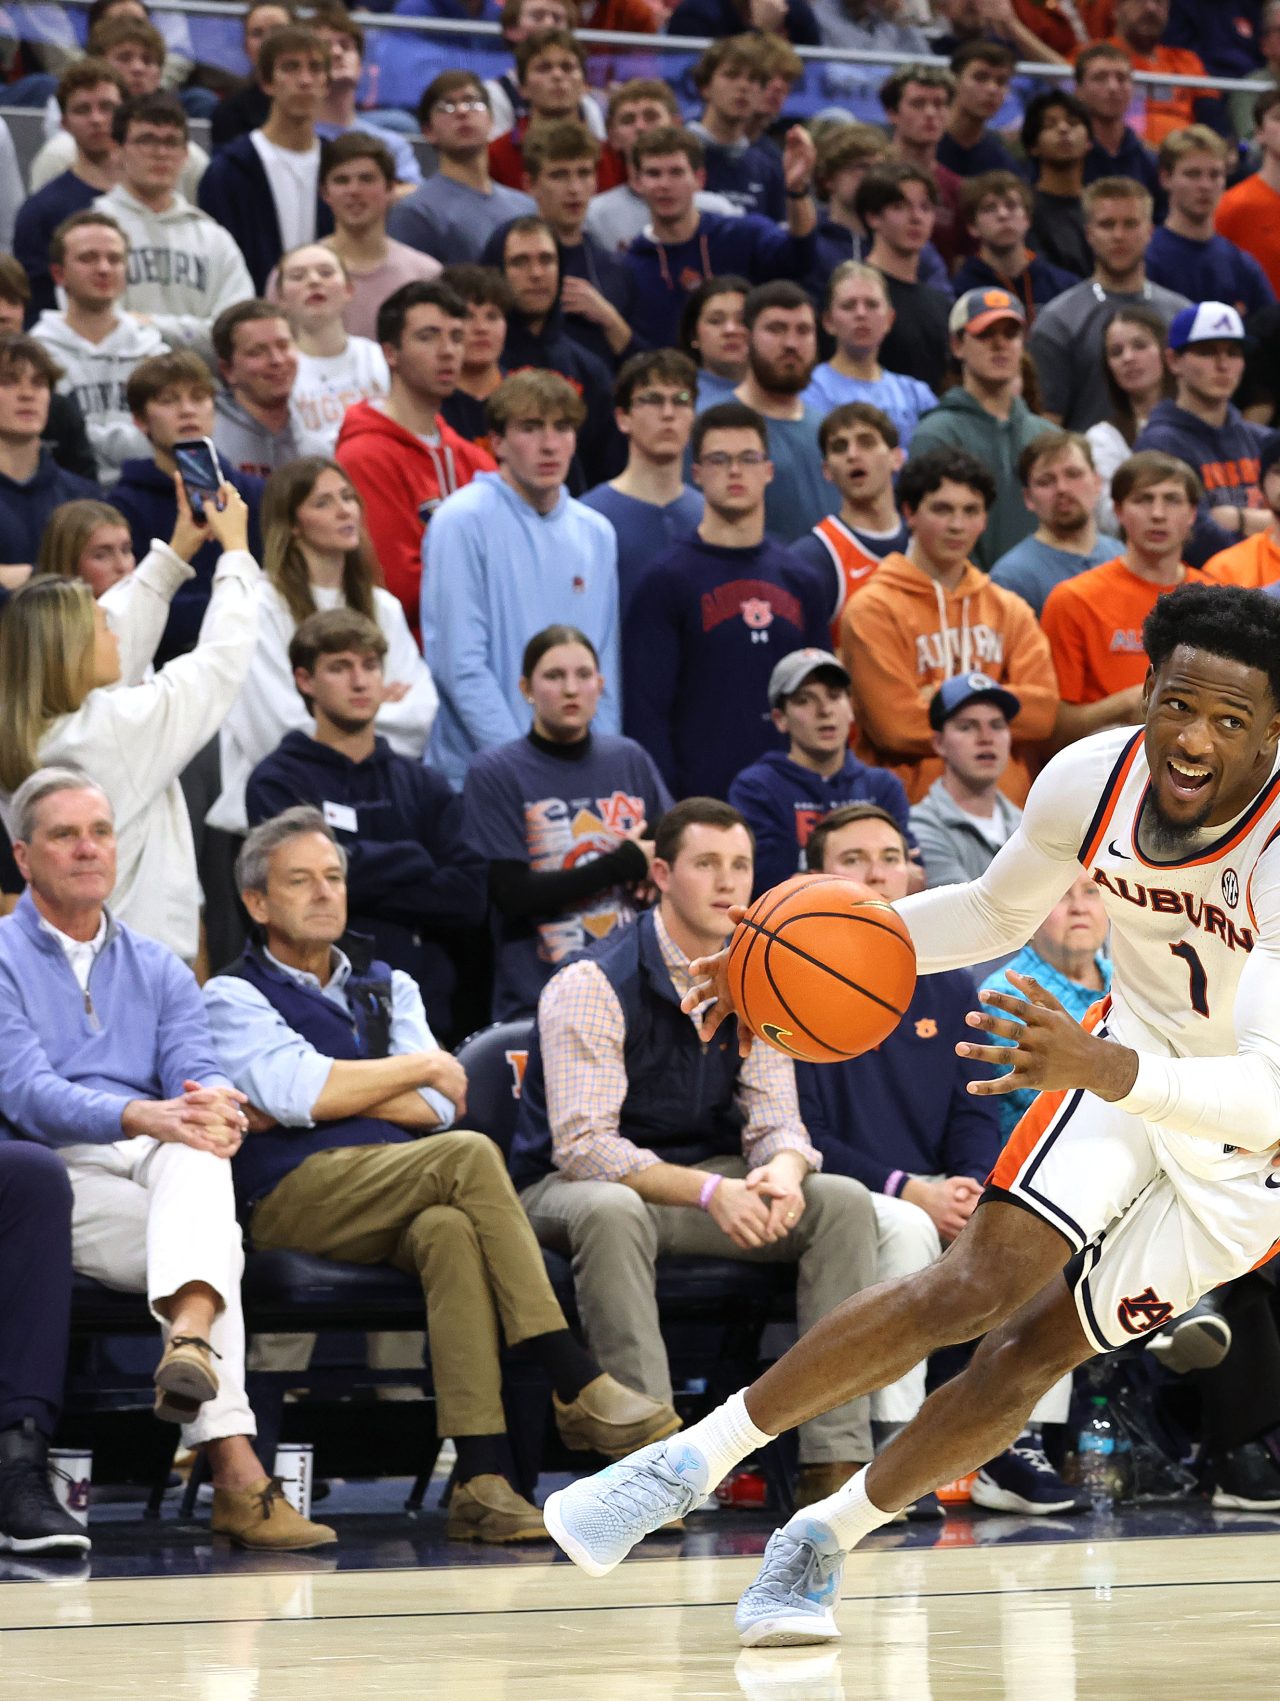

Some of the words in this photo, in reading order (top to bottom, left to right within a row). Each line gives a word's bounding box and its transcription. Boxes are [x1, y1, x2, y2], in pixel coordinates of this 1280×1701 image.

[1093, 867, 1255, 954] AUBURN
[1222, 868, 1240, 909] SEC
[1169, 930, 1210, 1019] 1
